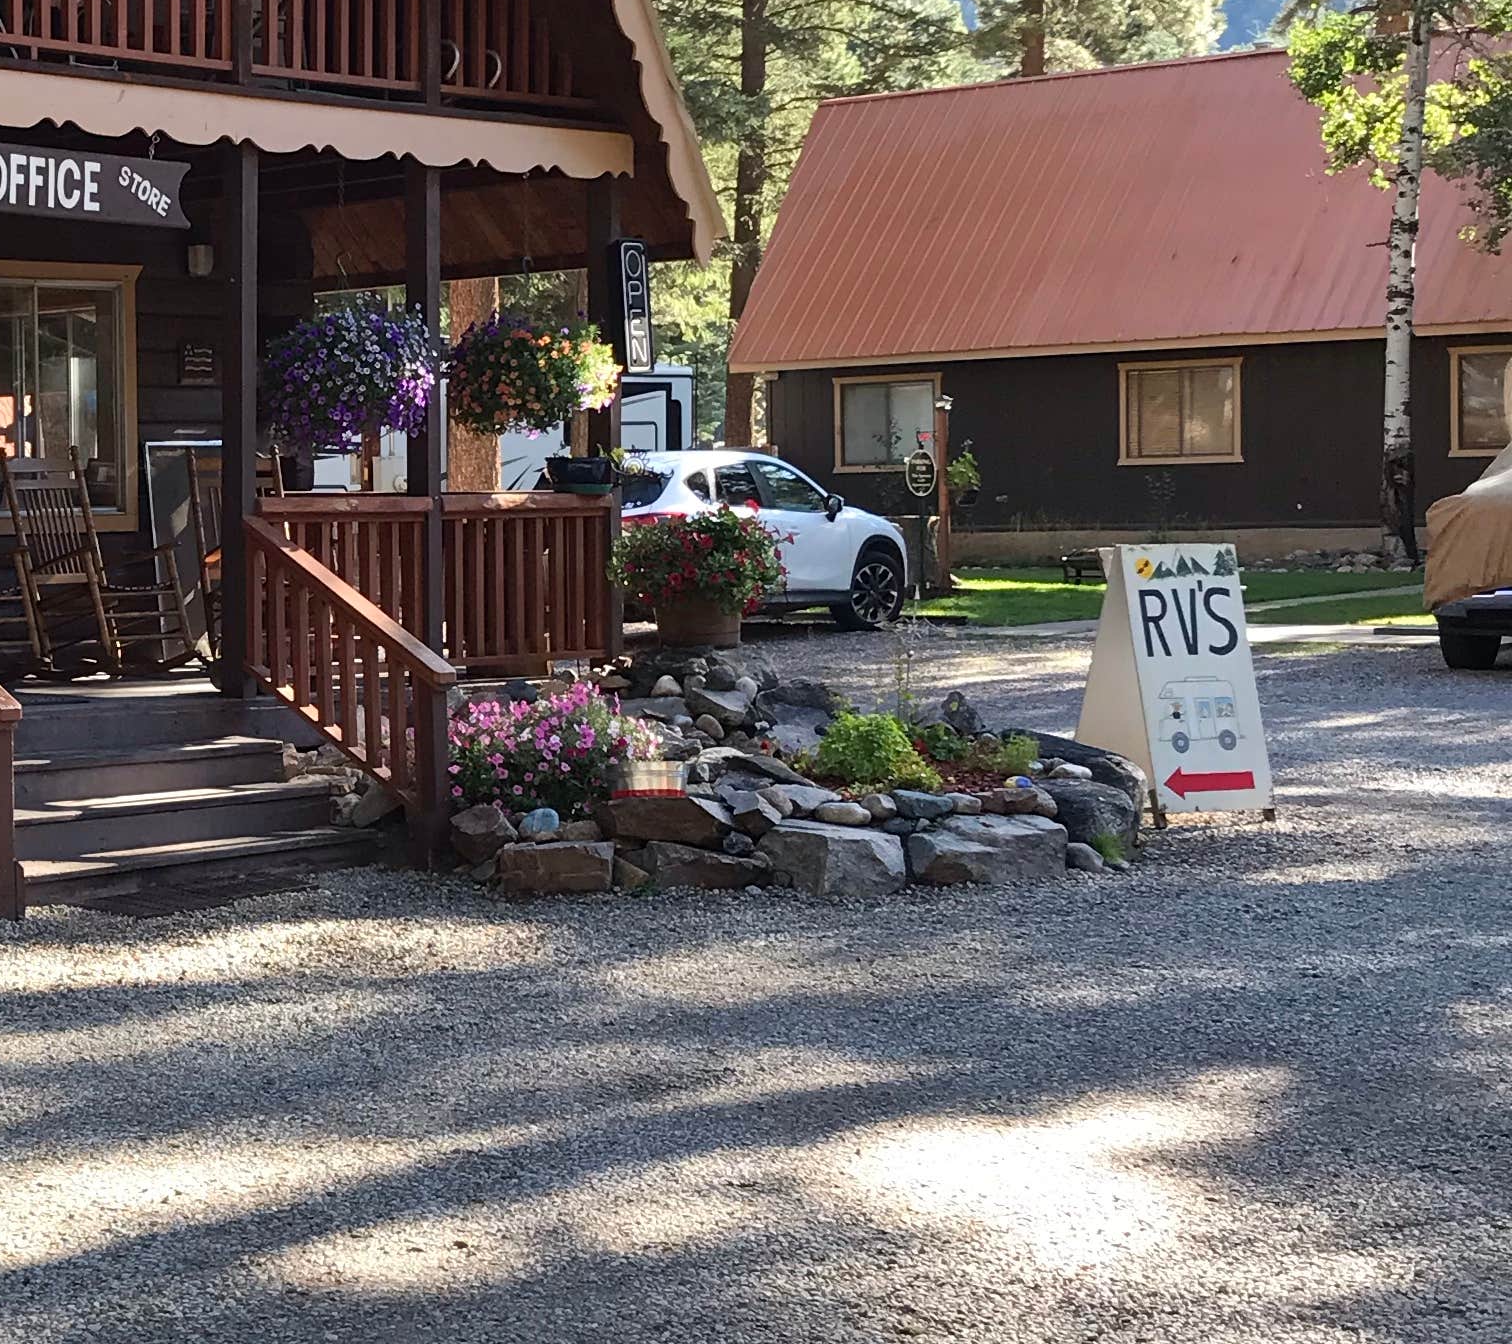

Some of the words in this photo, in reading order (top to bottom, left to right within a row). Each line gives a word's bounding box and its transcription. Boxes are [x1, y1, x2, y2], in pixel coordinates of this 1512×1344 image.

[118, 166, 172, 217] STORE
[624, 249, 648, 365] OPEN
[1138, 579, 1238, 657] RV'S
